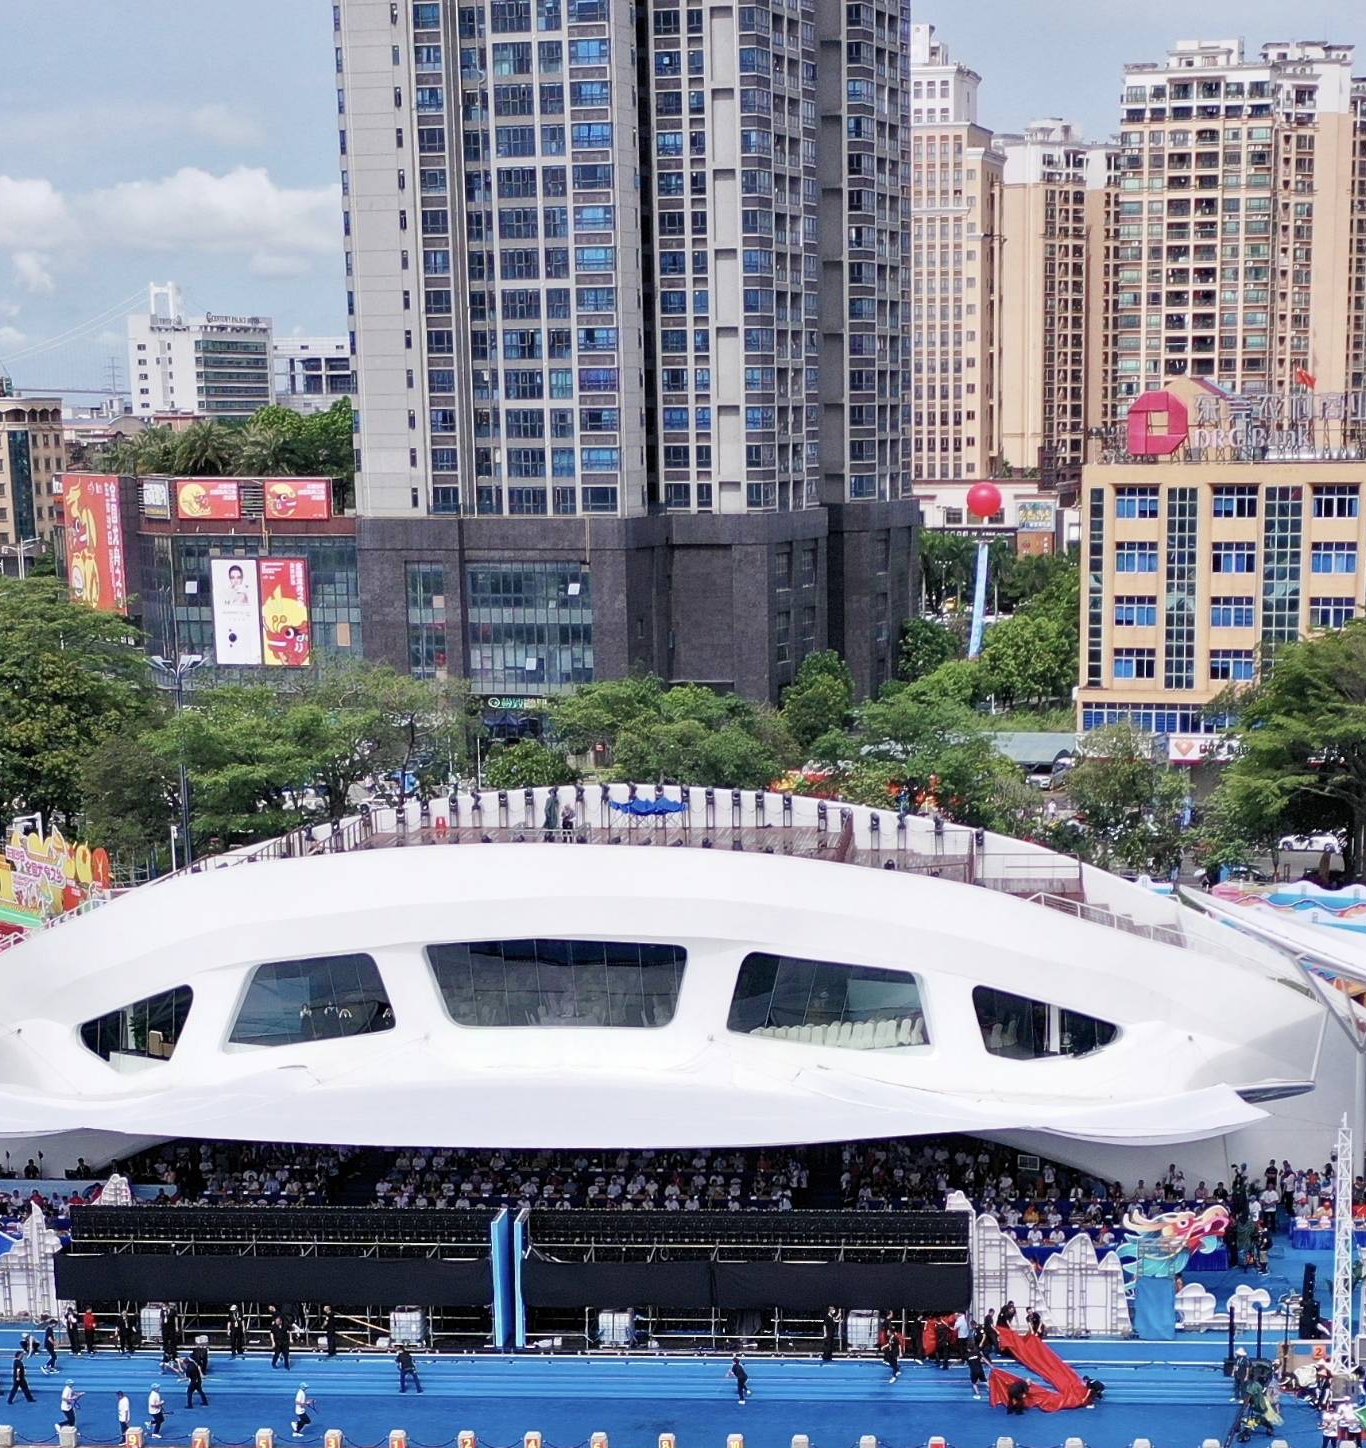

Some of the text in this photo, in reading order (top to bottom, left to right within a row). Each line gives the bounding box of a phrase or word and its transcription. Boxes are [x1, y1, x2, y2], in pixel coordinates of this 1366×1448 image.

[1194, 427, 1311, 447] DRC Bank
[1316, 1347, 1324, 1356] 2
[129, 1434, 137, 1446] 9
[527, 1439, 536, 1448] 4
